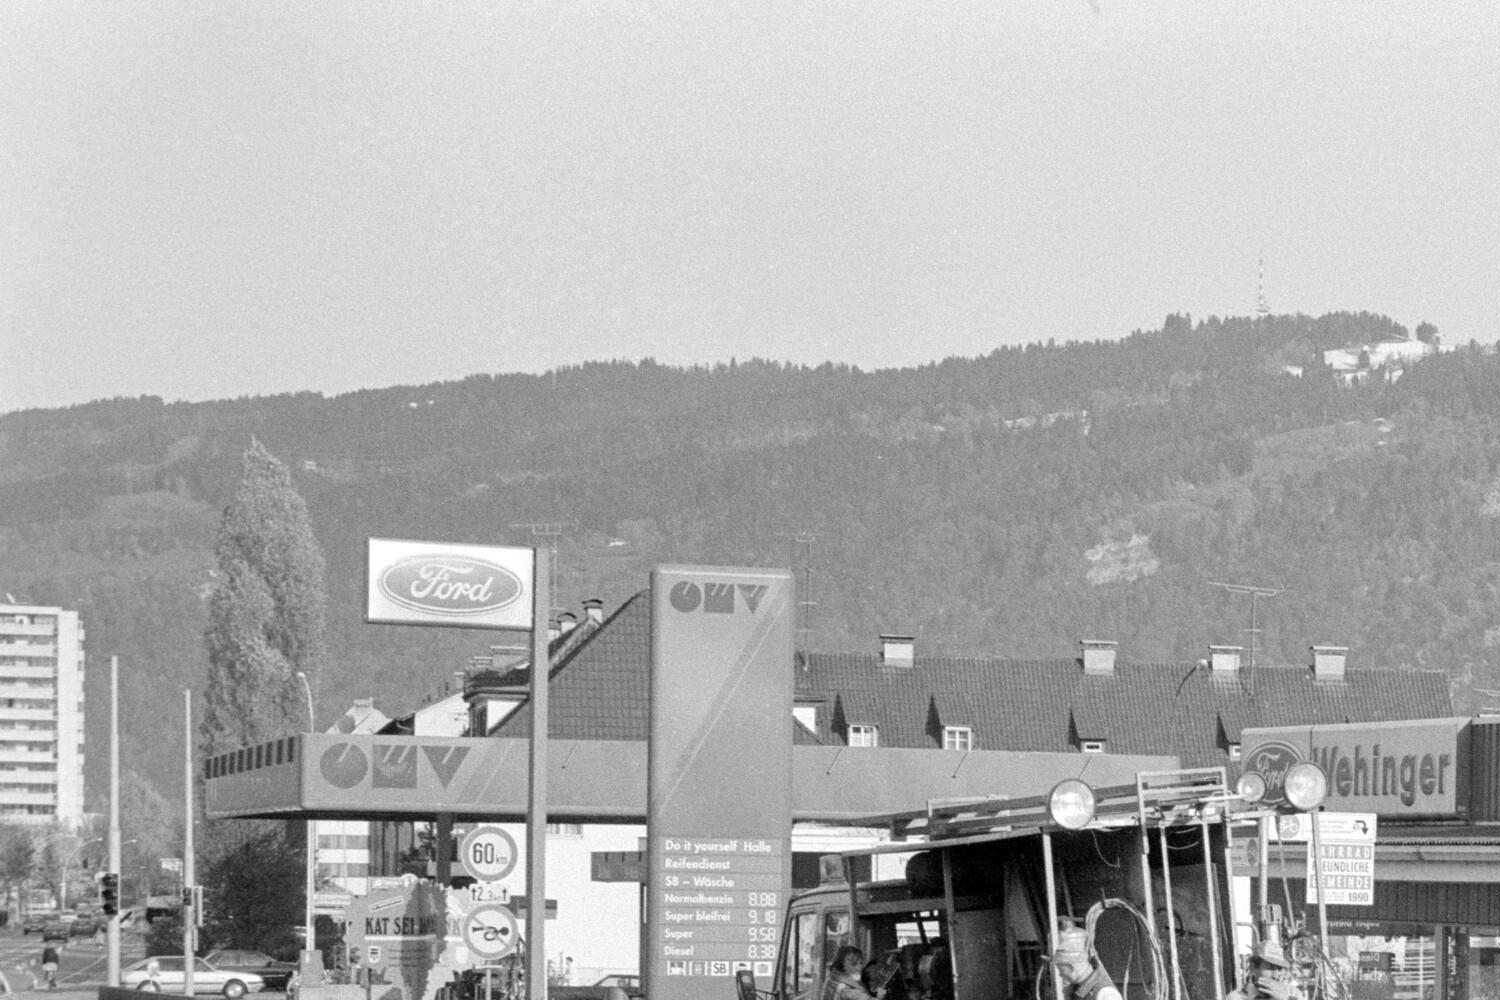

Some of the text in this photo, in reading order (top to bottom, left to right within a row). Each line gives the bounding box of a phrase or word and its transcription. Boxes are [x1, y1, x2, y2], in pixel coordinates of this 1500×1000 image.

[411, 564, 494, 601] Ford
[670, 581, 769, 614] OMV
[320, 742, 471, 790] OMV
[1314, 744, 1450, 807] Wehinger
[473, 842, 495, 864] 60
[665, 840, 772, 853] Do it yourself Halle
[1313, 845, 1370, 858] AHRRAD
[665, 858, 731, 869] Reifendienst
[665, 876, 679, 886] SB
[693, 876, 735, 887] Wäsche
[664, 892, 777, 907] Normalbenzin 8.88
[1348, 892, 1369, 902] 1990
[665, 910, 776, 924] Super bleifrei 9.18
[365, 917, 390, 935] KAT
[394, 917, 414, 935] SEI
[665, 927, 776, 942] Super 9.58
[664, 944, 776, 959] Diesel 8.38
[713, 963, 726, 973] SB
